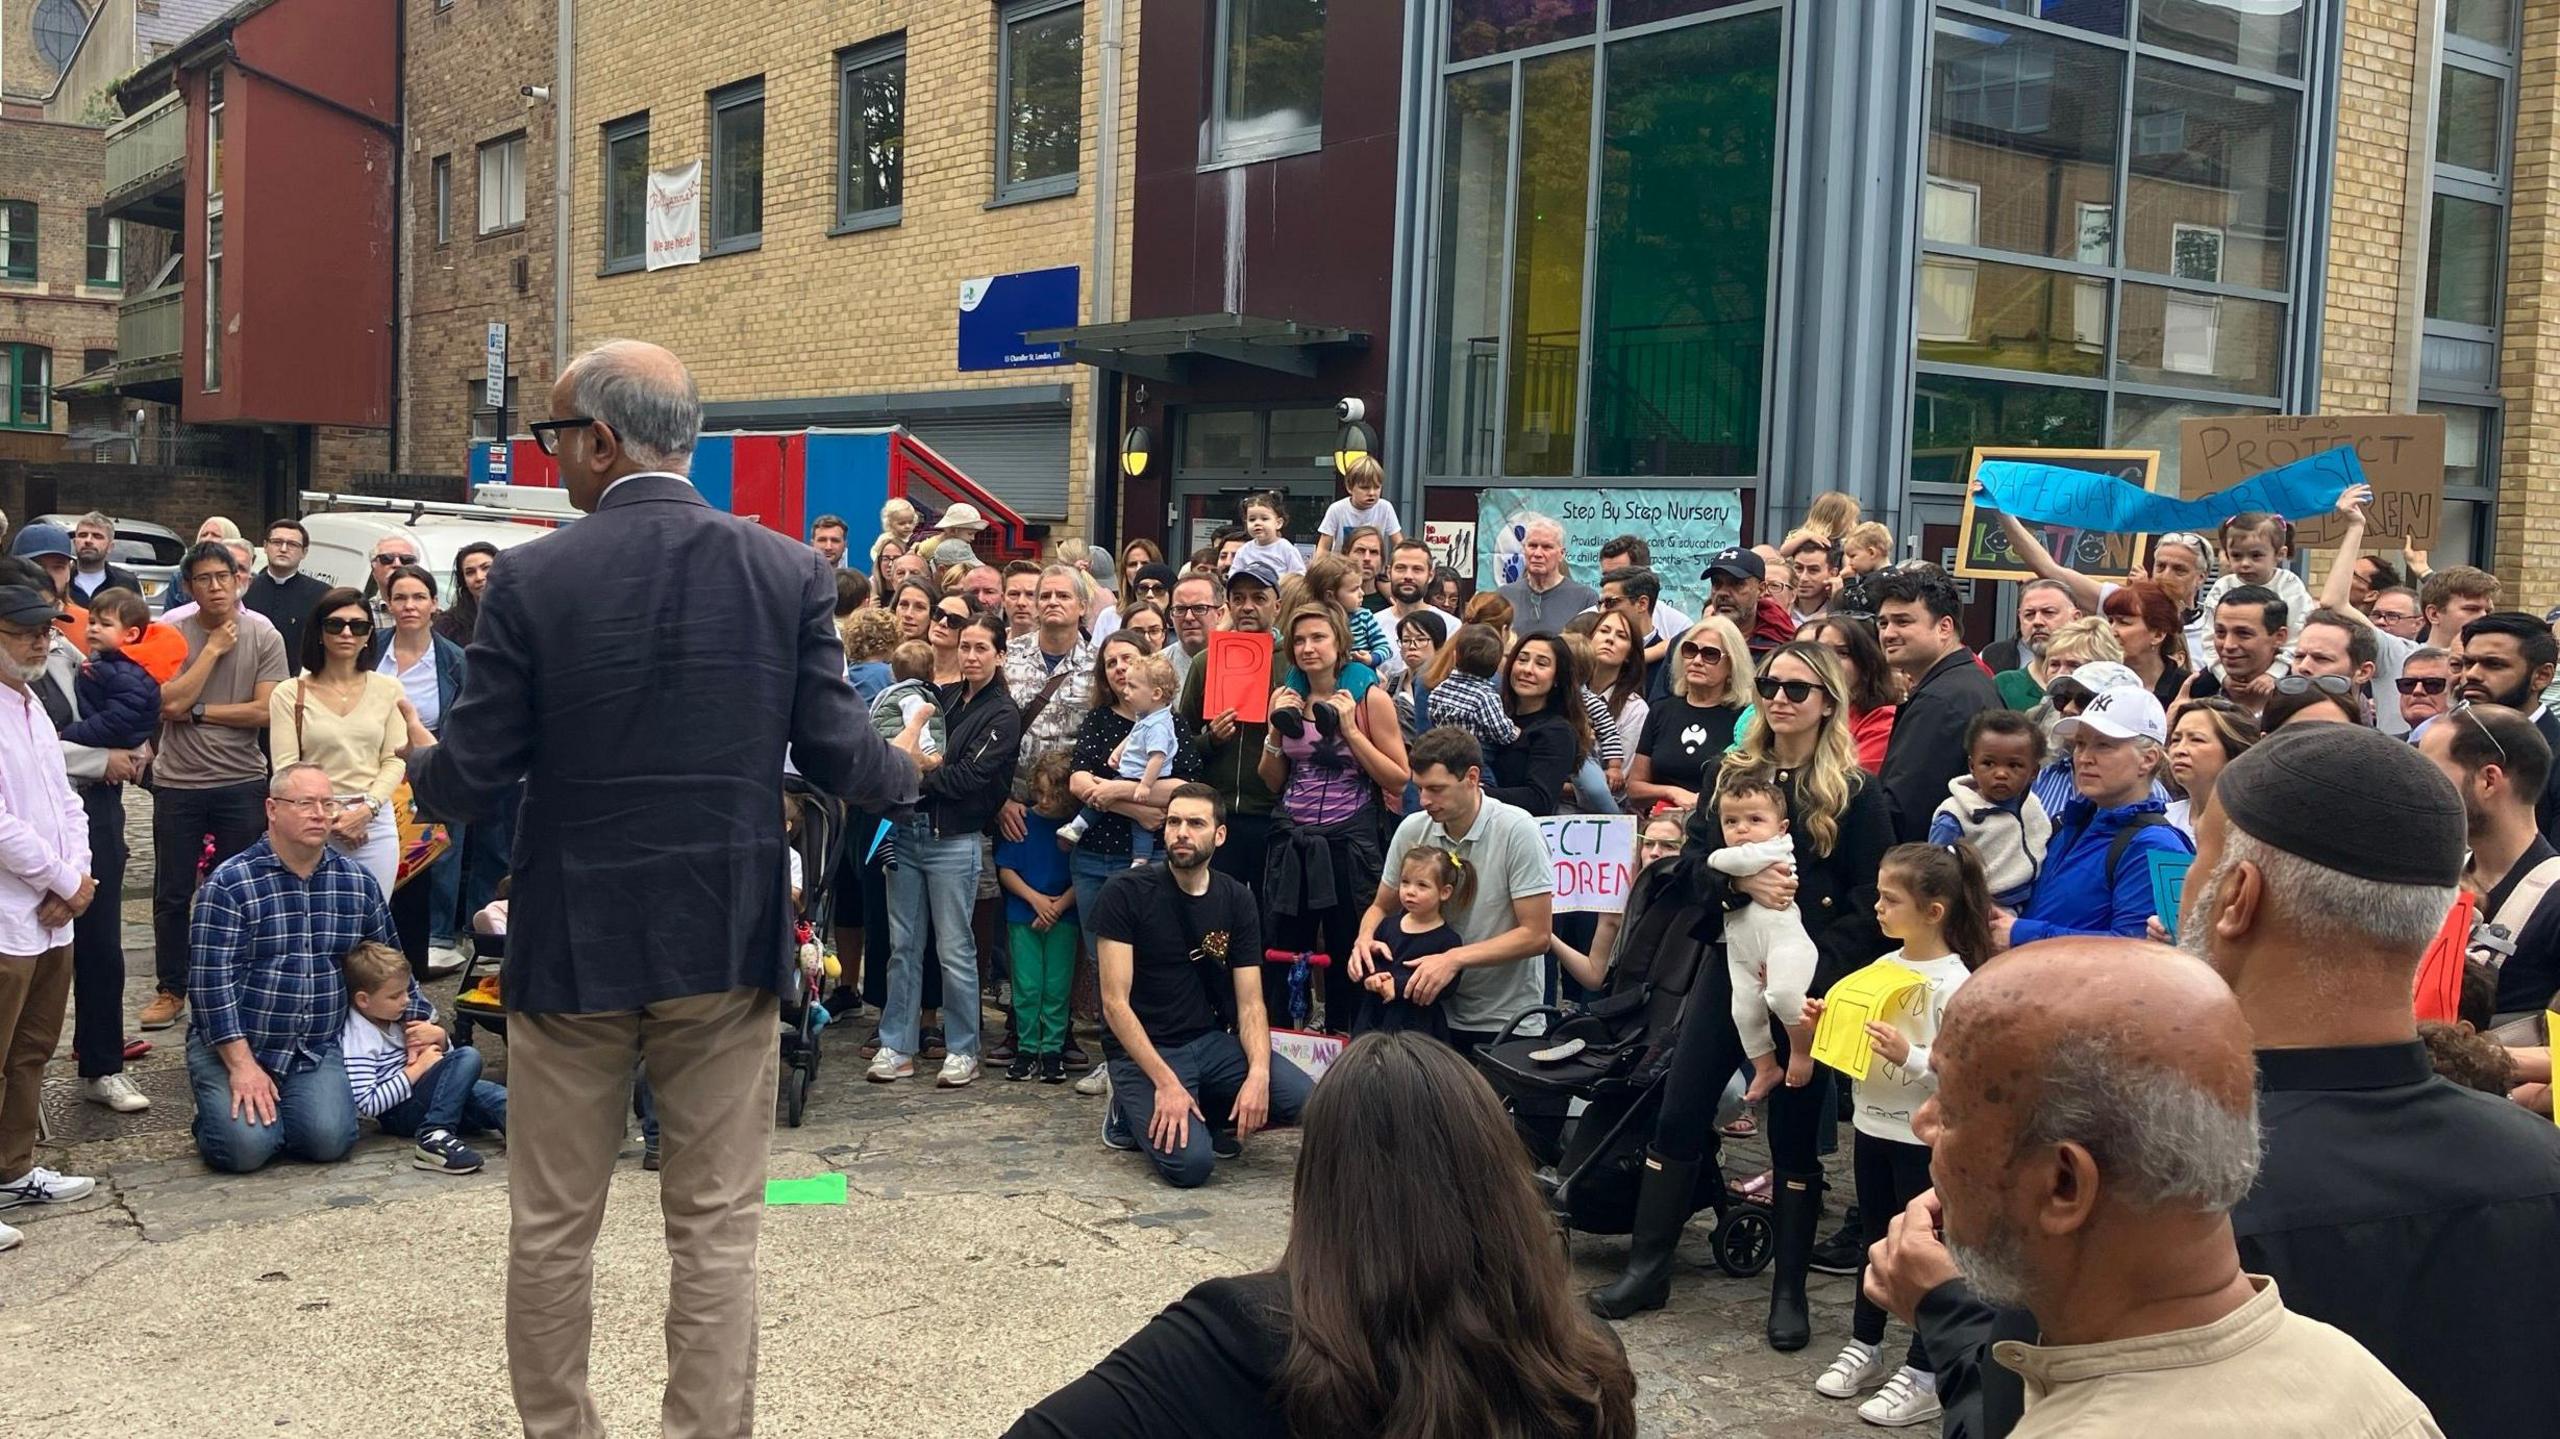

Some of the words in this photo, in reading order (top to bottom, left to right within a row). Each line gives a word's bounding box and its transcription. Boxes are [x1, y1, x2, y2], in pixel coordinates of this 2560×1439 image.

[2266, 417, 2307, 434] HELP
[2322, 417, 2341, 430] US
[1562, 500, 1596, 525] Step
[1601, 500, 1621, 525] By
[1624, 501, 1663, 525] Step
[1667, 501, 1730, 526] Nursery
[1667, 535, 1676, 548] &
[1678, 536, 1727, 550] education
[1693, 554, 1701, 566] 5
[1212, 637, 1265, 716] P
